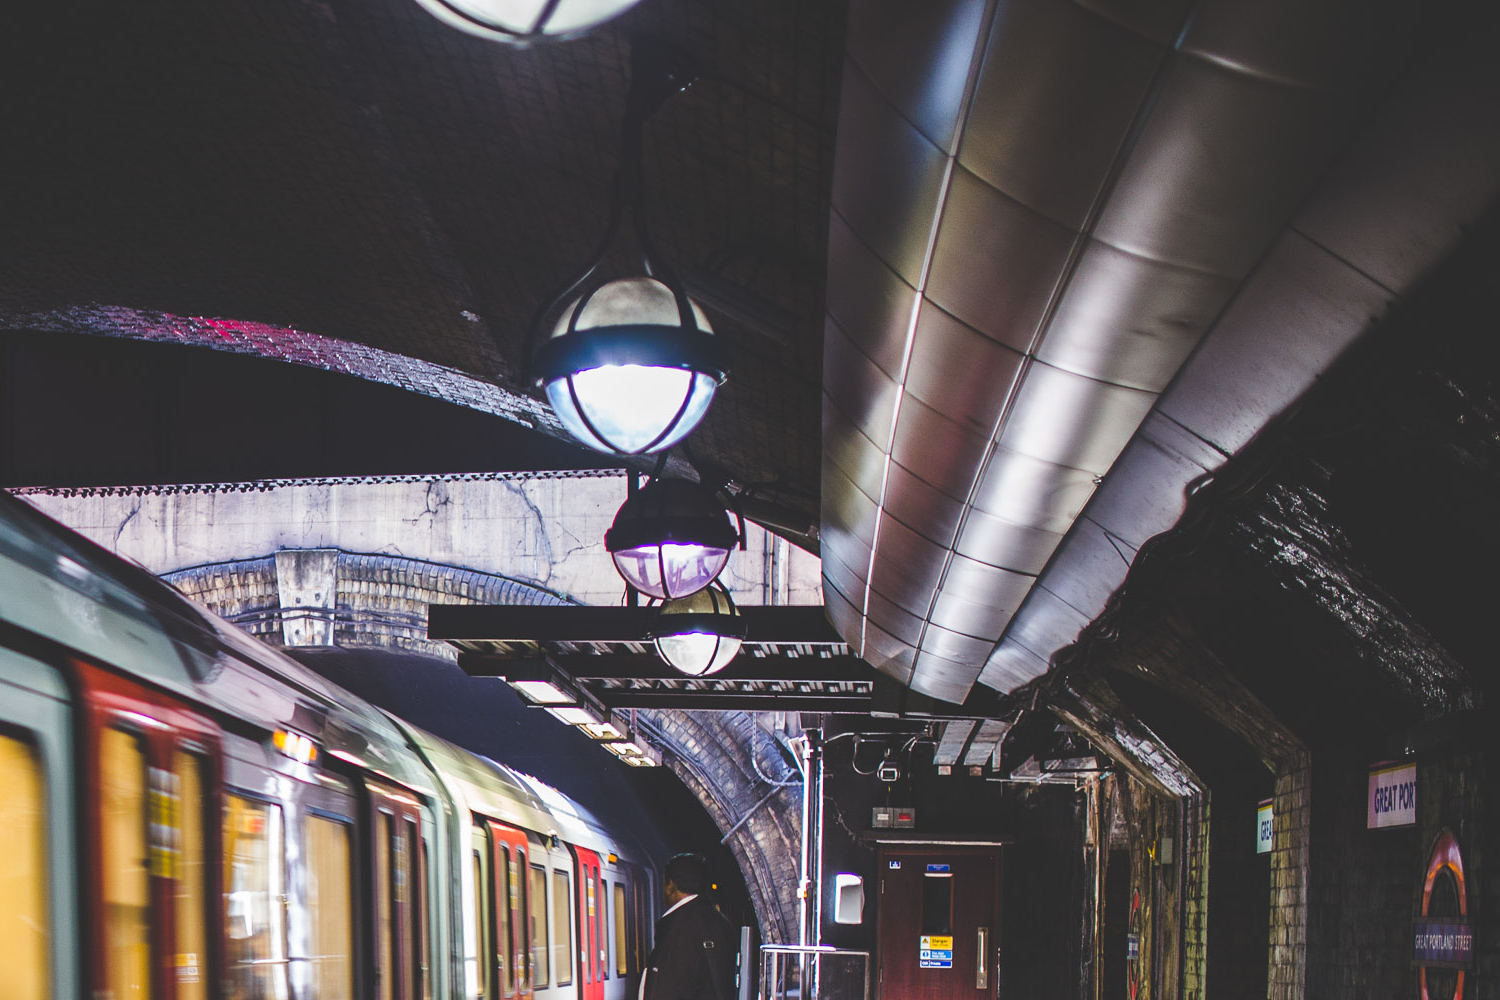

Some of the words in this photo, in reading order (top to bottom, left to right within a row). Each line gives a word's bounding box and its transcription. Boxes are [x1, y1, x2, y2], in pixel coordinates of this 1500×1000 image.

[1375, 785, 1398, 814] GREAT
[1414, 934, 1429, 950] GREAT
[1429, 934, 1454, 950] PORTLAND
[1455, 934, 1472, 951] STREET
